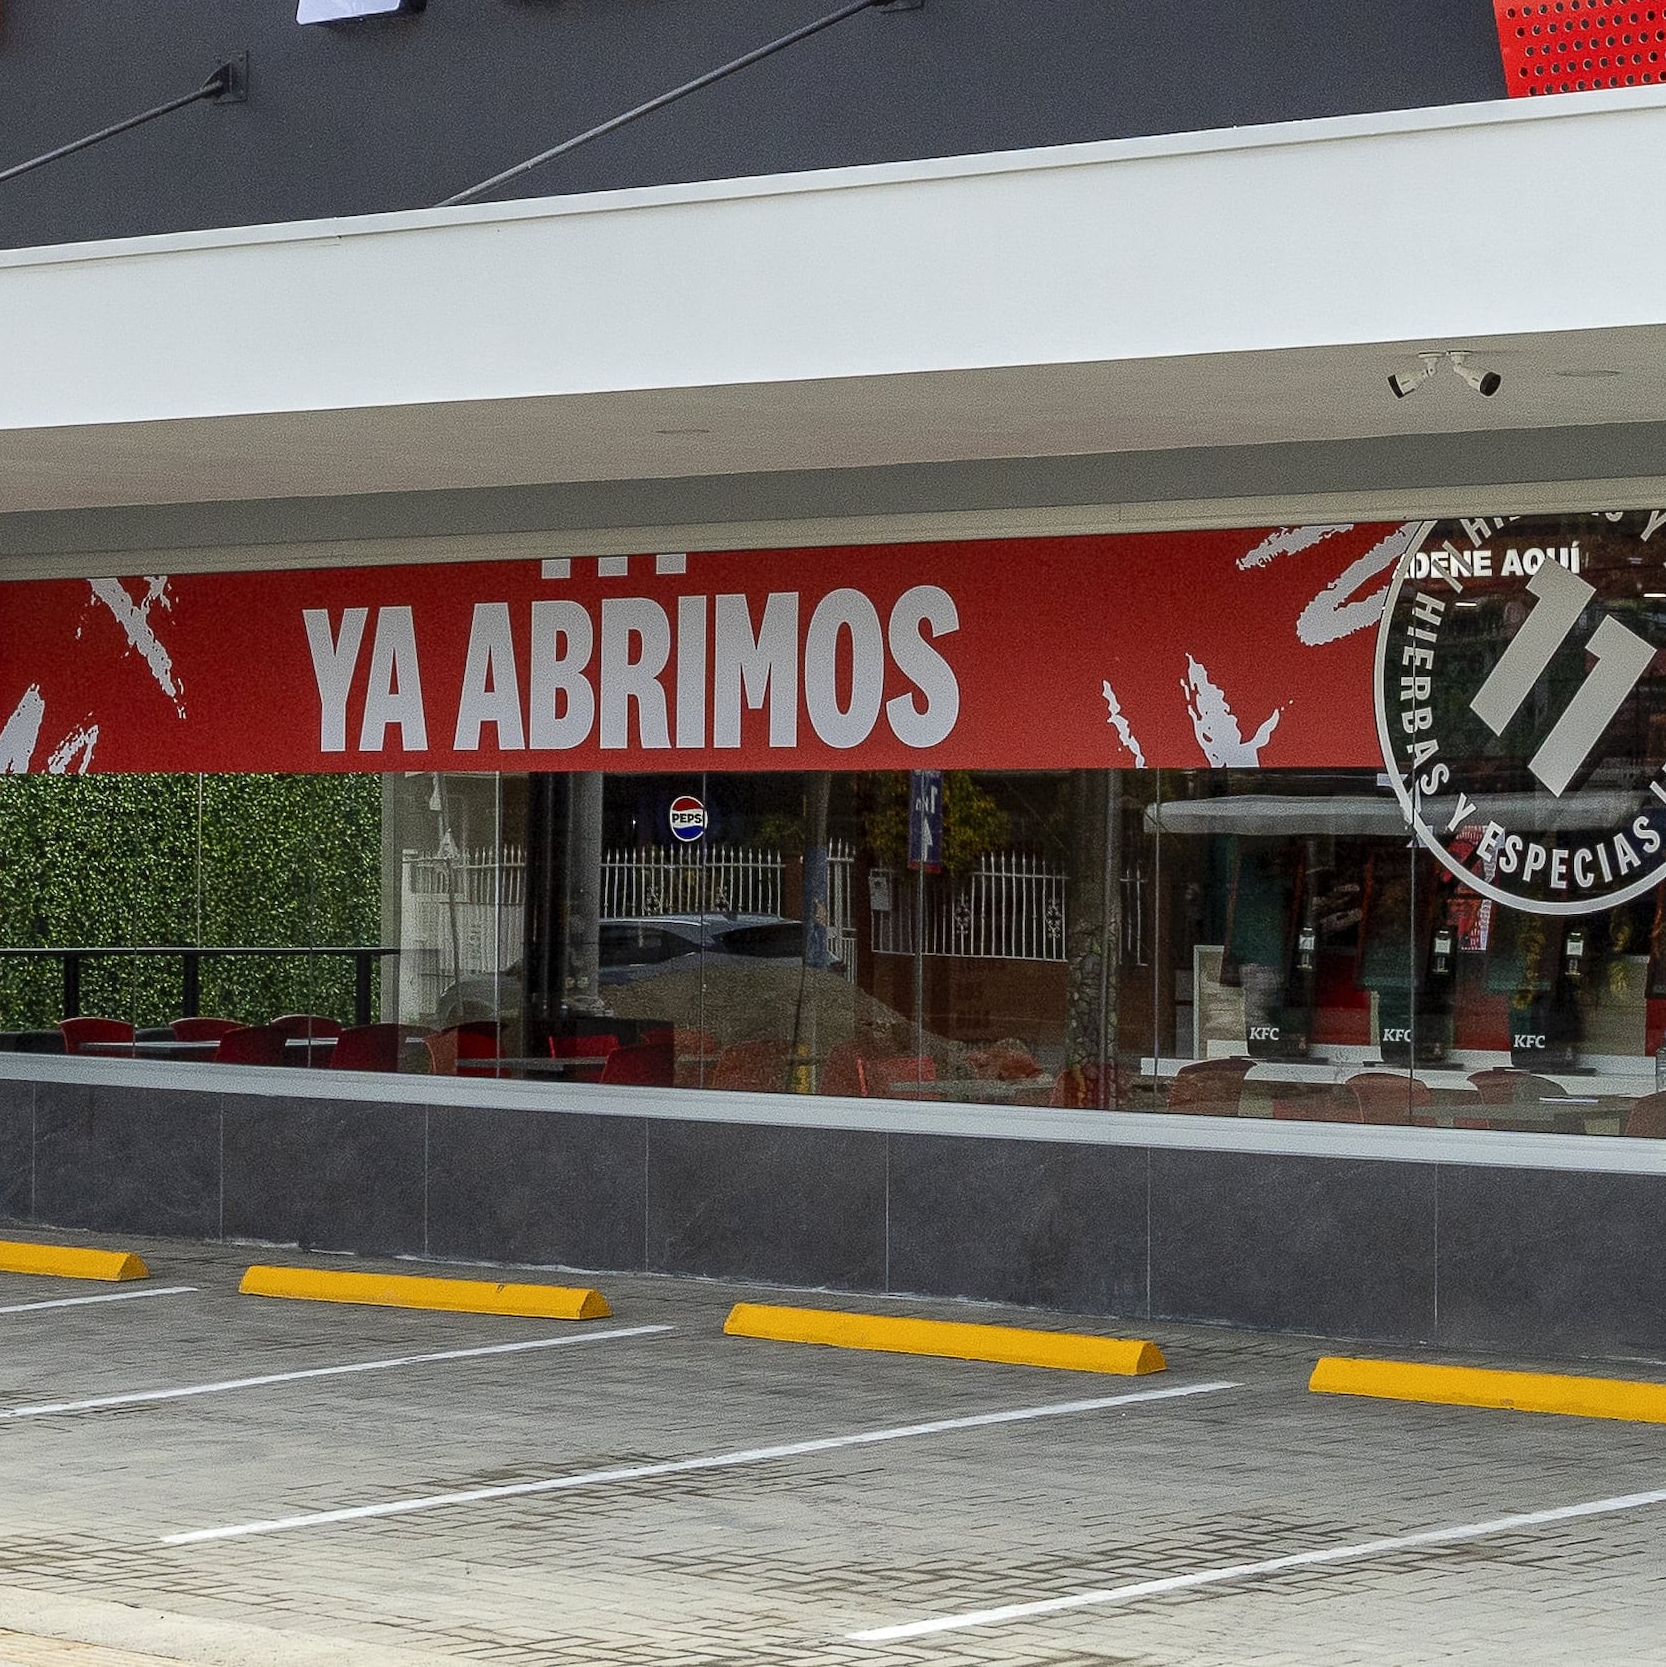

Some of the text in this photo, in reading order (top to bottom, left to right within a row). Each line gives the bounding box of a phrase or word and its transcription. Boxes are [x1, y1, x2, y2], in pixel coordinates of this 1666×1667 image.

[302, 584, 960, 752] YA ABRIMOS
[1400, 592, 1450, 795] HIERBAS
[1446, 792, 1477, 832] Y
[1476, 815, 1661, 889] ESPECIAS
[672, 813, 702, 824] PEPS
[1249, 1027, 1280, 1041] KFC
[1513, 1035, 1546, 1049] KFC
